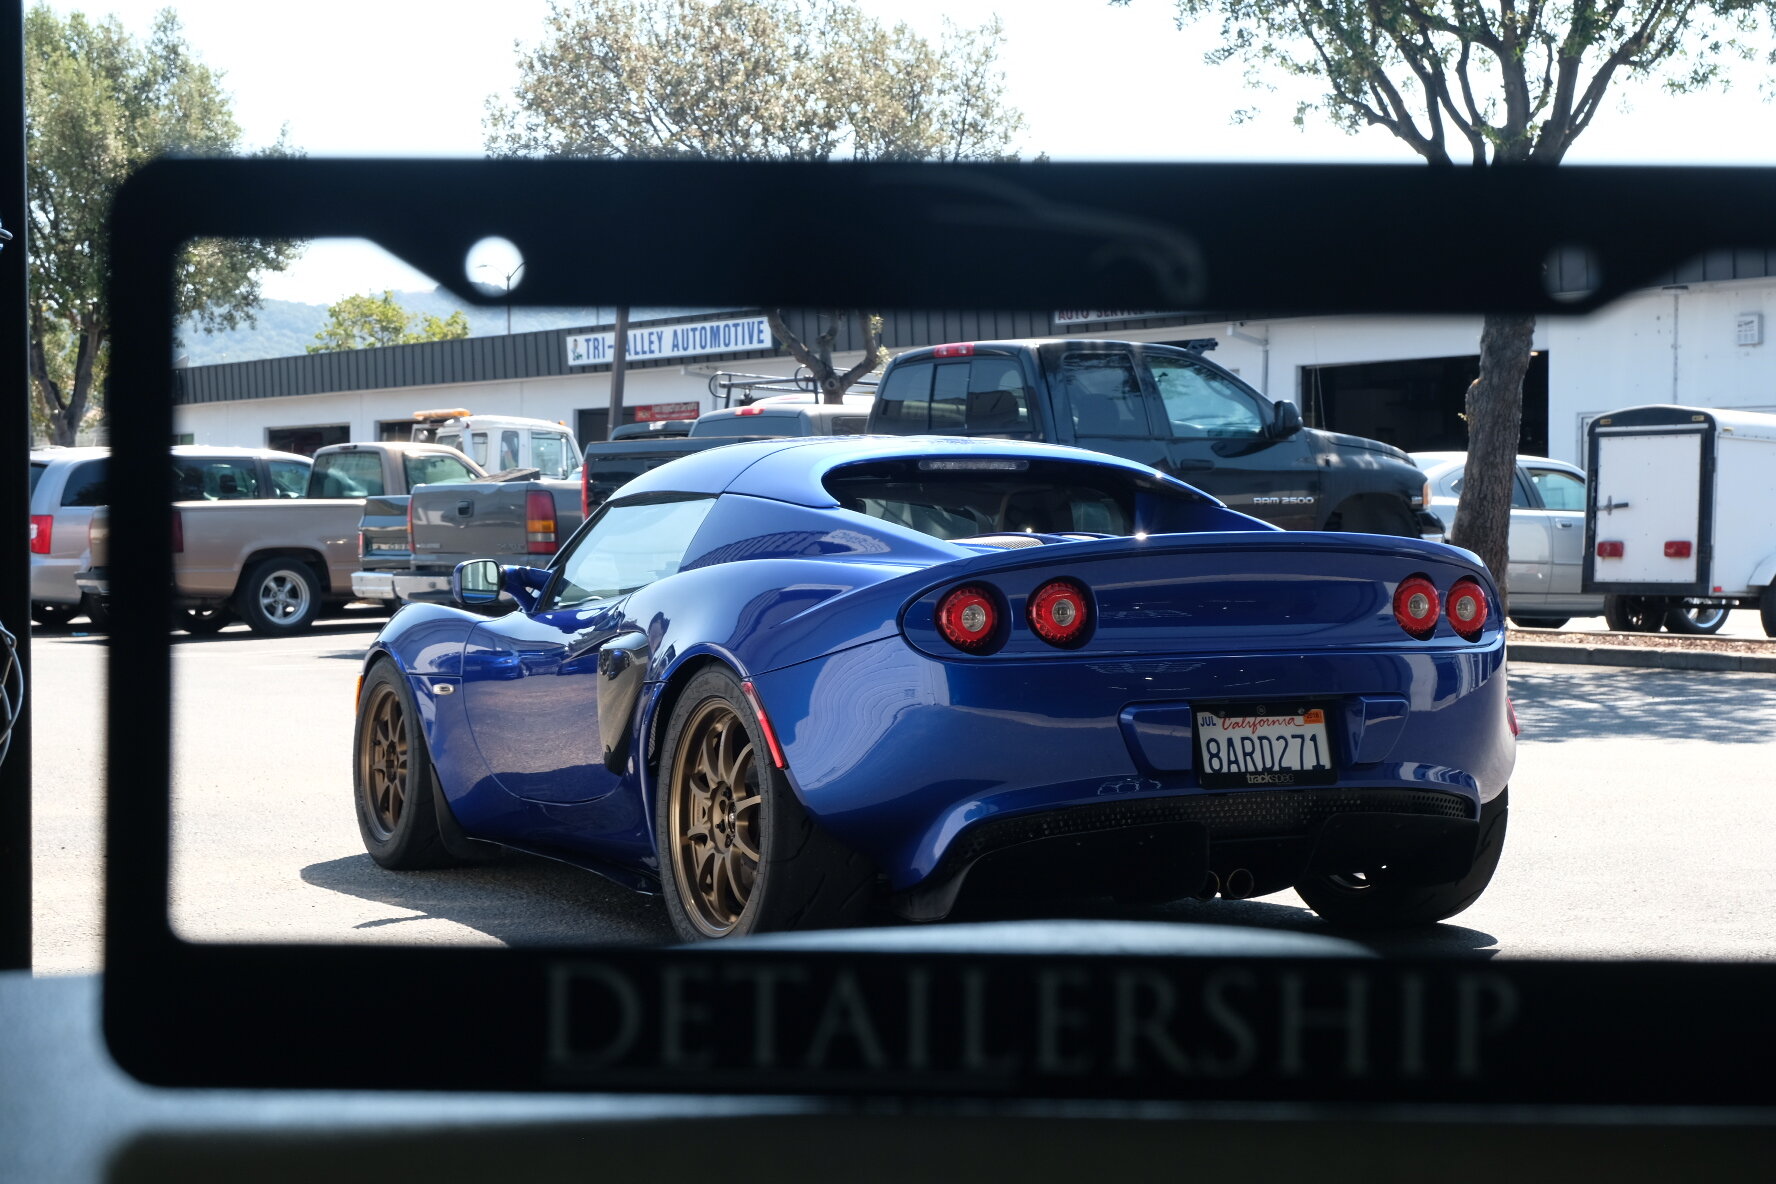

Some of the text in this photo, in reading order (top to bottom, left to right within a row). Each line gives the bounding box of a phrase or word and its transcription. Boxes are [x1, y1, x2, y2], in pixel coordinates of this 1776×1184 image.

[584, 320, 765, 360] TRI-ALLEY AUTOMOTIVE
[1281, 496, 1314, 504] 2500
[1200, 715, 1216, 727] JUL
[1221, 716, 1304, 734] California
[1206, 733, 1326, 773] 8ARD271
[1246, 772, 1295, 785] trackspec
[545, 965, 1518, 1077] DETAILERSHIP
